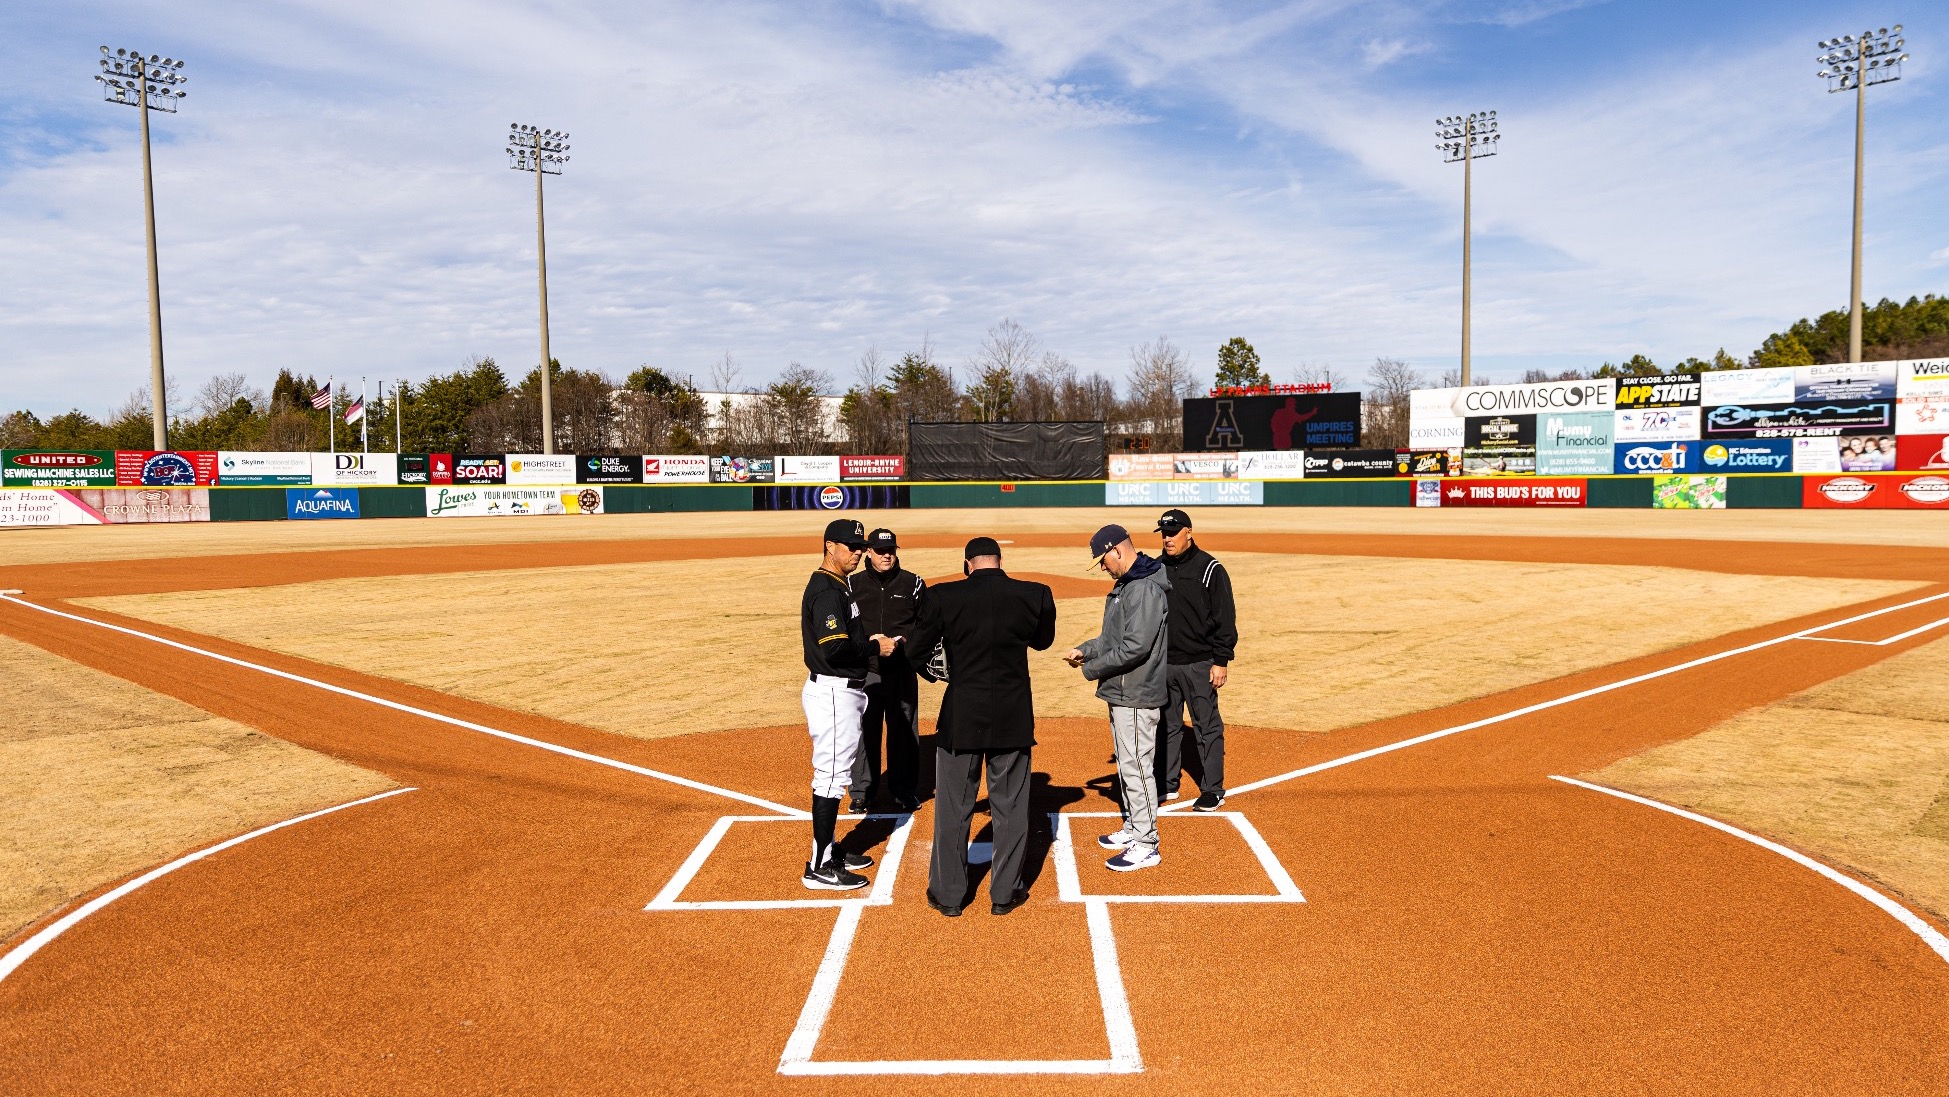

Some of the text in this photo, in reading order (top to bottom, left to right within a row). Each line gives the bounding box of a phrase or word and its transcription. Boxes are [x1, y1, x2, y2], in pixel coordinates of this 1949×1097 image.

[1810, 364, 1879, 375] BLACK TIE
[1639, 376, 1663, 384] CLOSE.
[1703, 373, 1753, 383] LEGACY
[1274, 383, 1331, 395] STADIUM
[1466, 385, 1608, 411] COMMSCOPE
[1306, 421, 1354, 432] UMPIRES
[1546, 418, 1592, 438] Mumy
[1410, 427, 1463, 438] CORNING
[1556, 430, 1608, 446] Financial
[1755, 428, 1843, 438] 828-578-RENT
[1306, 433, 1354, 444] MEETING
[29, 456, 87, 464] UNITED
[241, 458, 306, 467] Skyline National Bank
[711, 458, 723, 466] KEEP
[843, 459, 900, 467] LENOIR-RHYNE
[1371, 460, 1393, 468] county
[1729, 454, 1787, 469] Lottery
[4, 468, 115, 478] SEWING MACHINE SALES LLC
[456, 465, 503, 478] SOAR!
[849, 466, 895, 474] UNIVERSITY
[32, 479, 88, 487] (828) 327-0115
[1218, 482, 1250, 495] UNC
[1119, 483, 1150, 495] UNC
[1168, 483, 1200, 495] UNC
[1470, 486, 1580, 499] THIS BUD'S FOR YOU
[20, 492, 55, 501] Home
[484, 491, 556, 499] YOUR HOMETOWN TEAM
[17, 502, 58, 512] Home"
[295, 499, 353, 514] AQUAFINA
[431, 488, 477, 515] Lowes
[103, 504, 202, 515] CROWNE PLAZA
